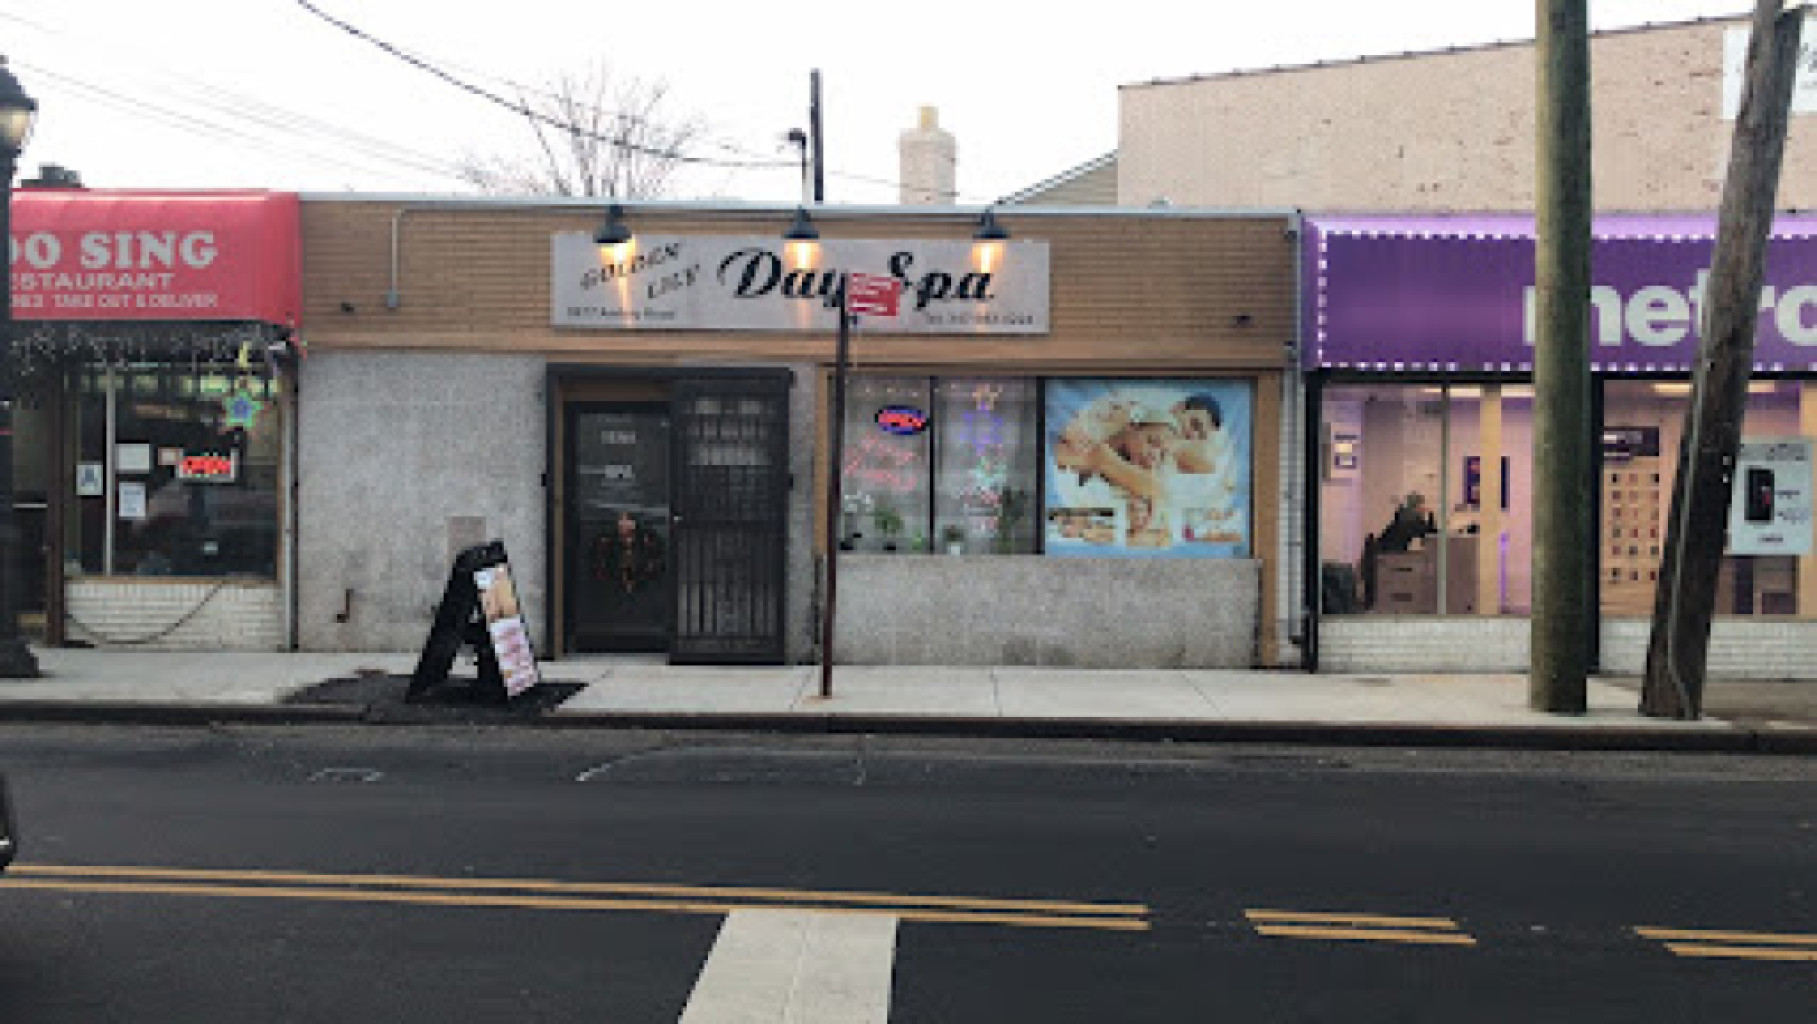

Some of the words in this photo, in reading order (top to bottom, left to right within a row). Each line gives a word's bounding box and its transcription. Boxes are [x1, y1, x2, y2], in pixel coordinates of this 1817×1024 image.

[9, 231, 61, 268] O
[80, 231, 218, 269] SING
[580, 241, 684, 290] GOLDEN
[716, 248, 844, 309] Day
[886, 250, 995, 312] Spa
